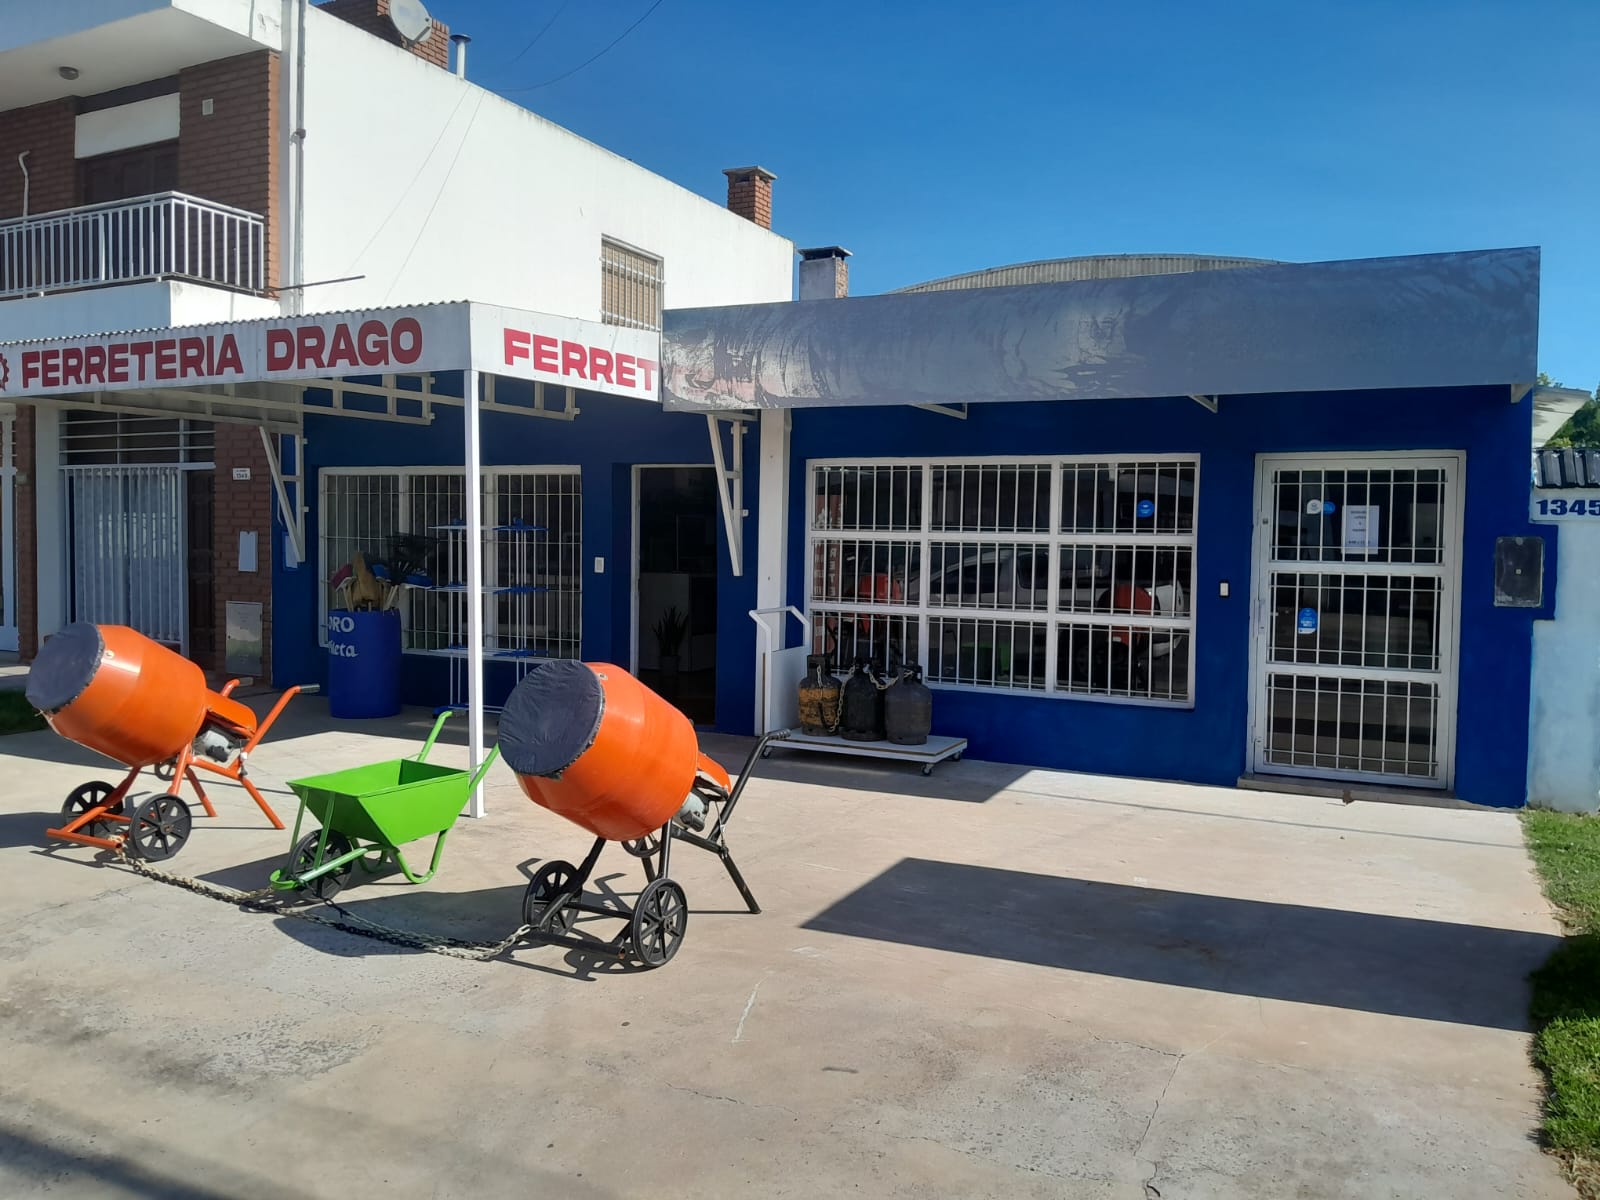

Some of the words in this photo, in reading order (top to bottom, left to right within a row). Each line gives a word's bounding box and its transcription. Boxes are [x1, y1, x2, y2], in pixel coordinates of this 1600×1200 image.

[22, 334, 244, 389] FERRETERIA
[267, 317, 423, 372] DRAGO
[503, 327, 658, 391] FERRET
[1536, 499, 1600, 516] 1345
